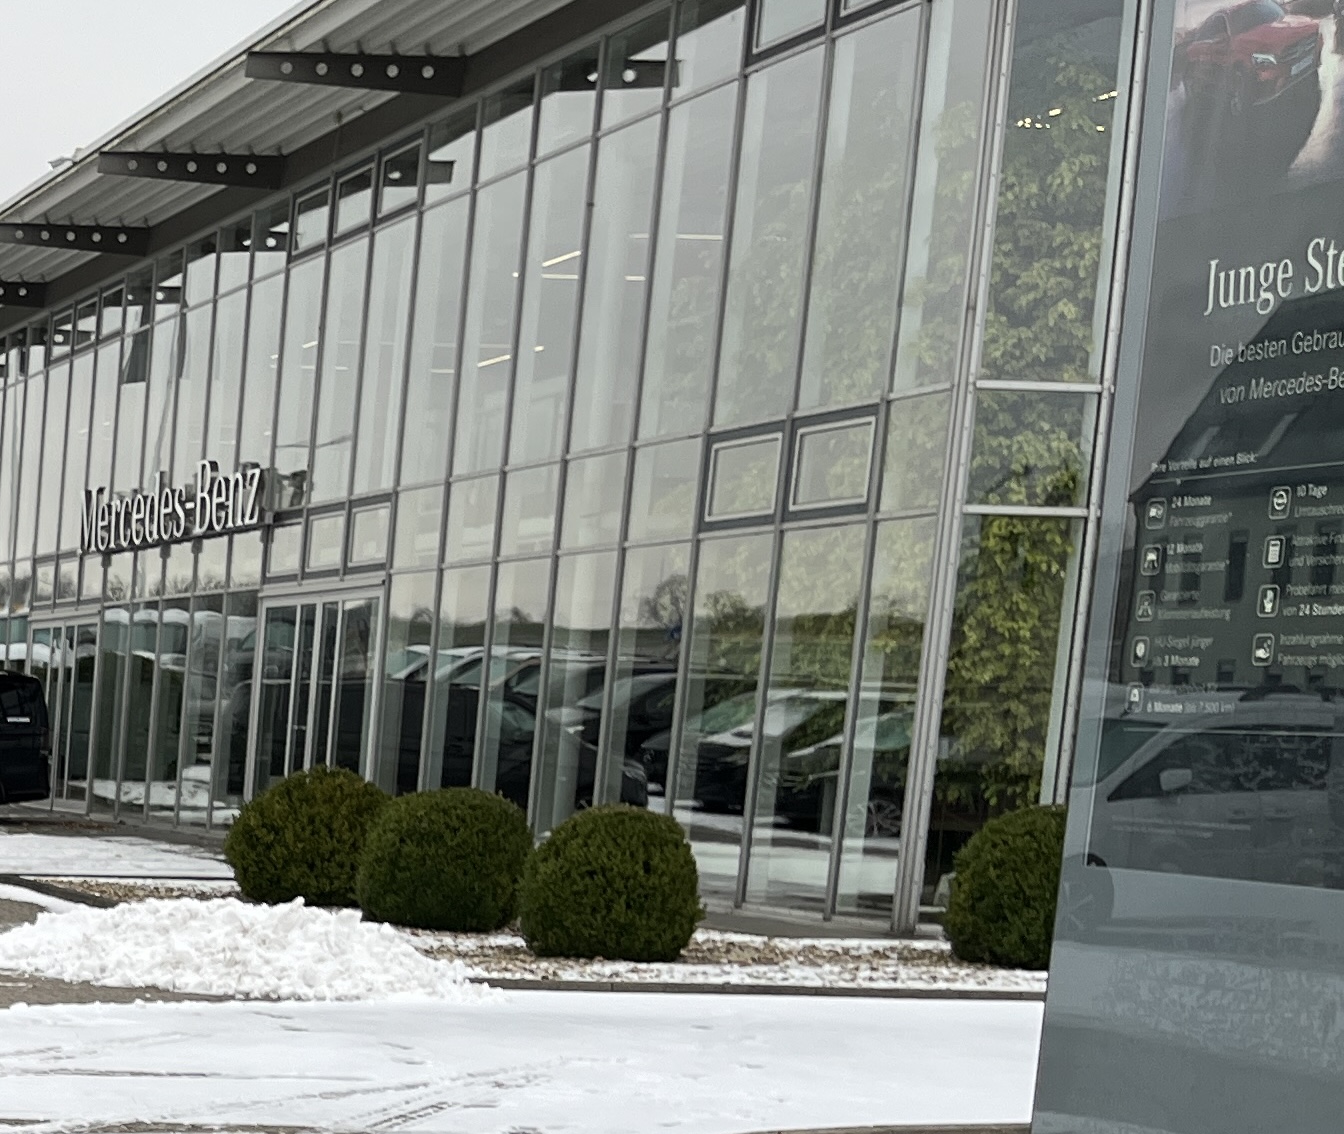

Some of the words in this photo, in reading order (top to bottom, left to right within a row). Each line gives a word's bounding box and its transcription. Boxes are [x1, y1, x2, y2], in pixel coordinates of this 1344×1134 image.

[1204, 258, 1293, 315] Junge
[1210, 343, 1234, 367] Die
[1238, 339, 1287, 363] besten
[1220, 385, 1246, 404] von
[1308, 484, 1328, 498] Tage
[79, 459, 262, 555] Mercedes-Benz
[1299, 603, 1311, 616] 24
